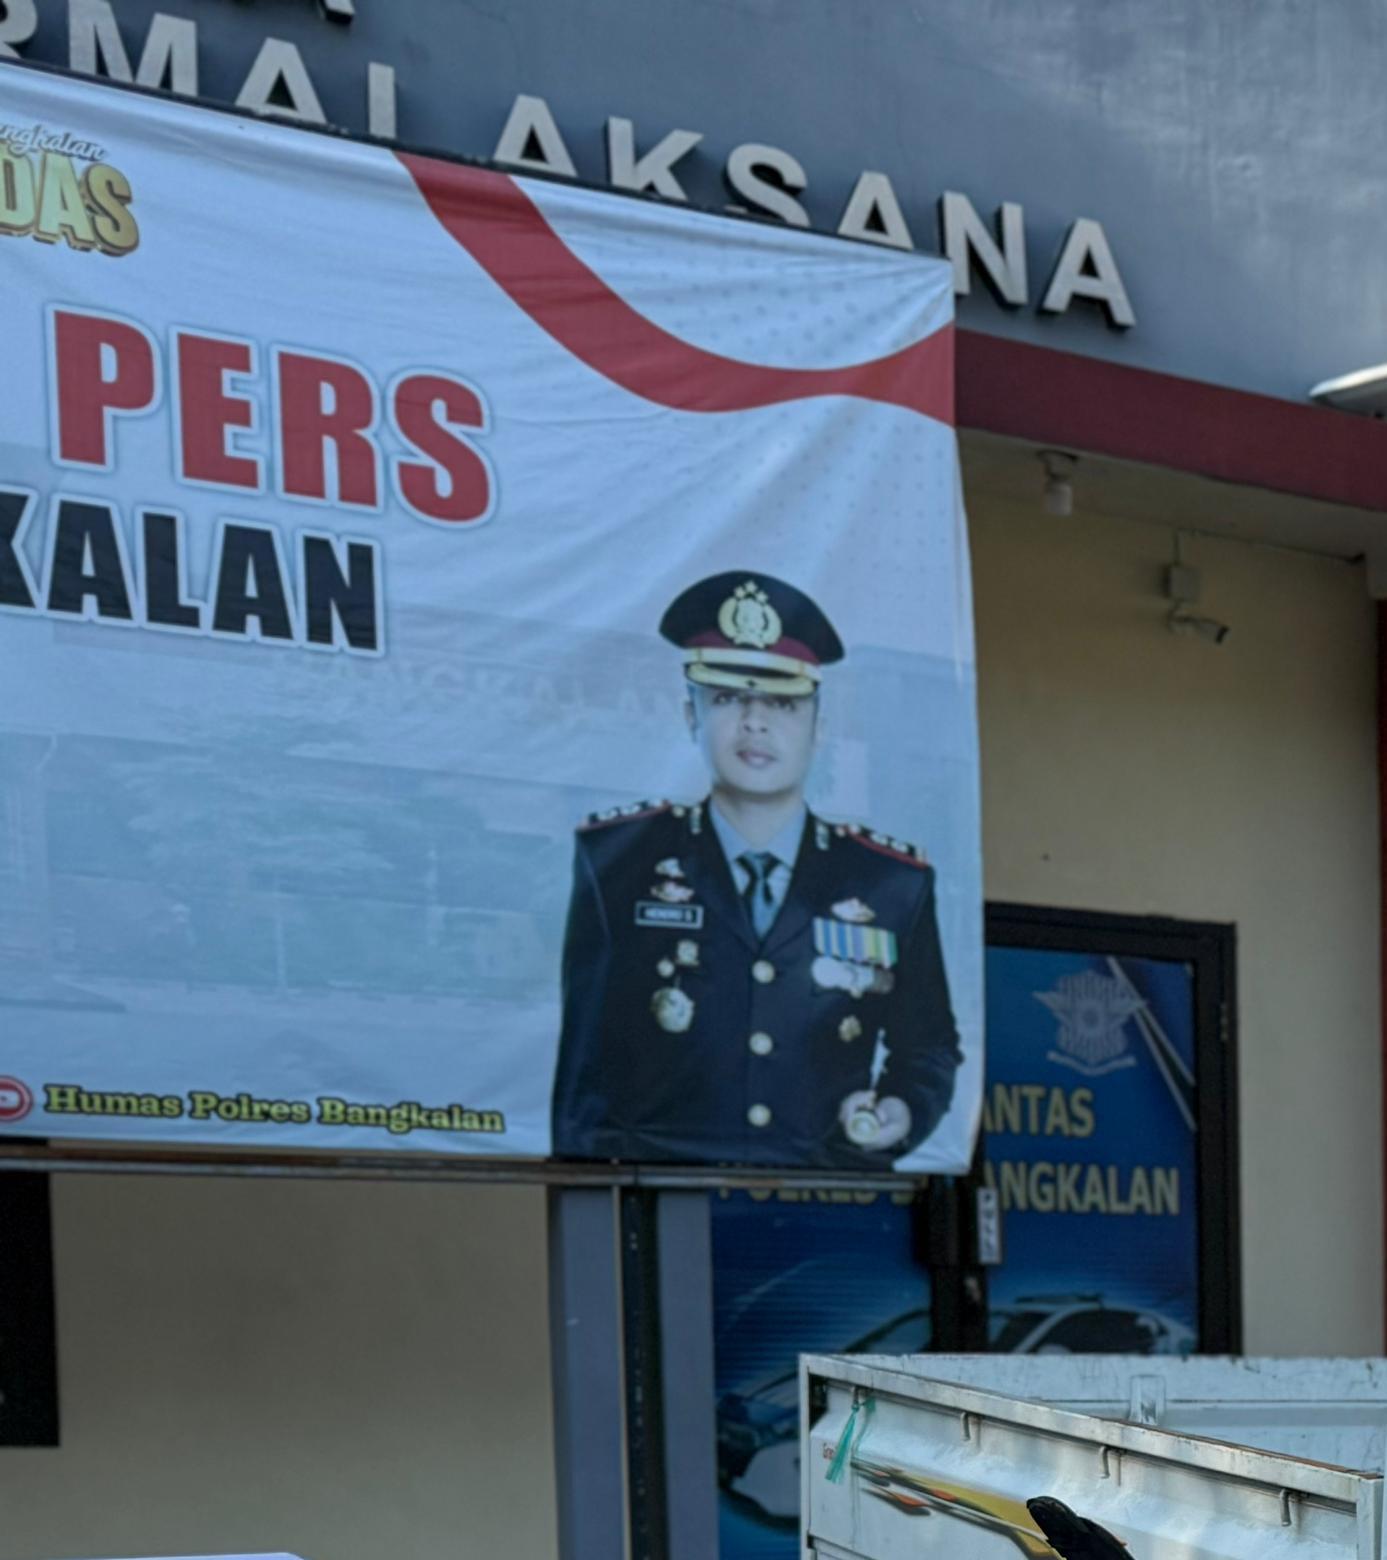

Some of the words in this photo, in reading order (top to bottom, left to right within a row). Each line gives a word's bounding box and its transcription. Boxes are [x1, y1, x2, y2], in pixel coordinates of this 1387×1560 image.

[53, 310, 491, 523] PERS
[44, 1084, 182, 1118] Humas
[189, 1090, 310, 1124] Polres
[317, 1095, 506, 1135] Bangkalan
